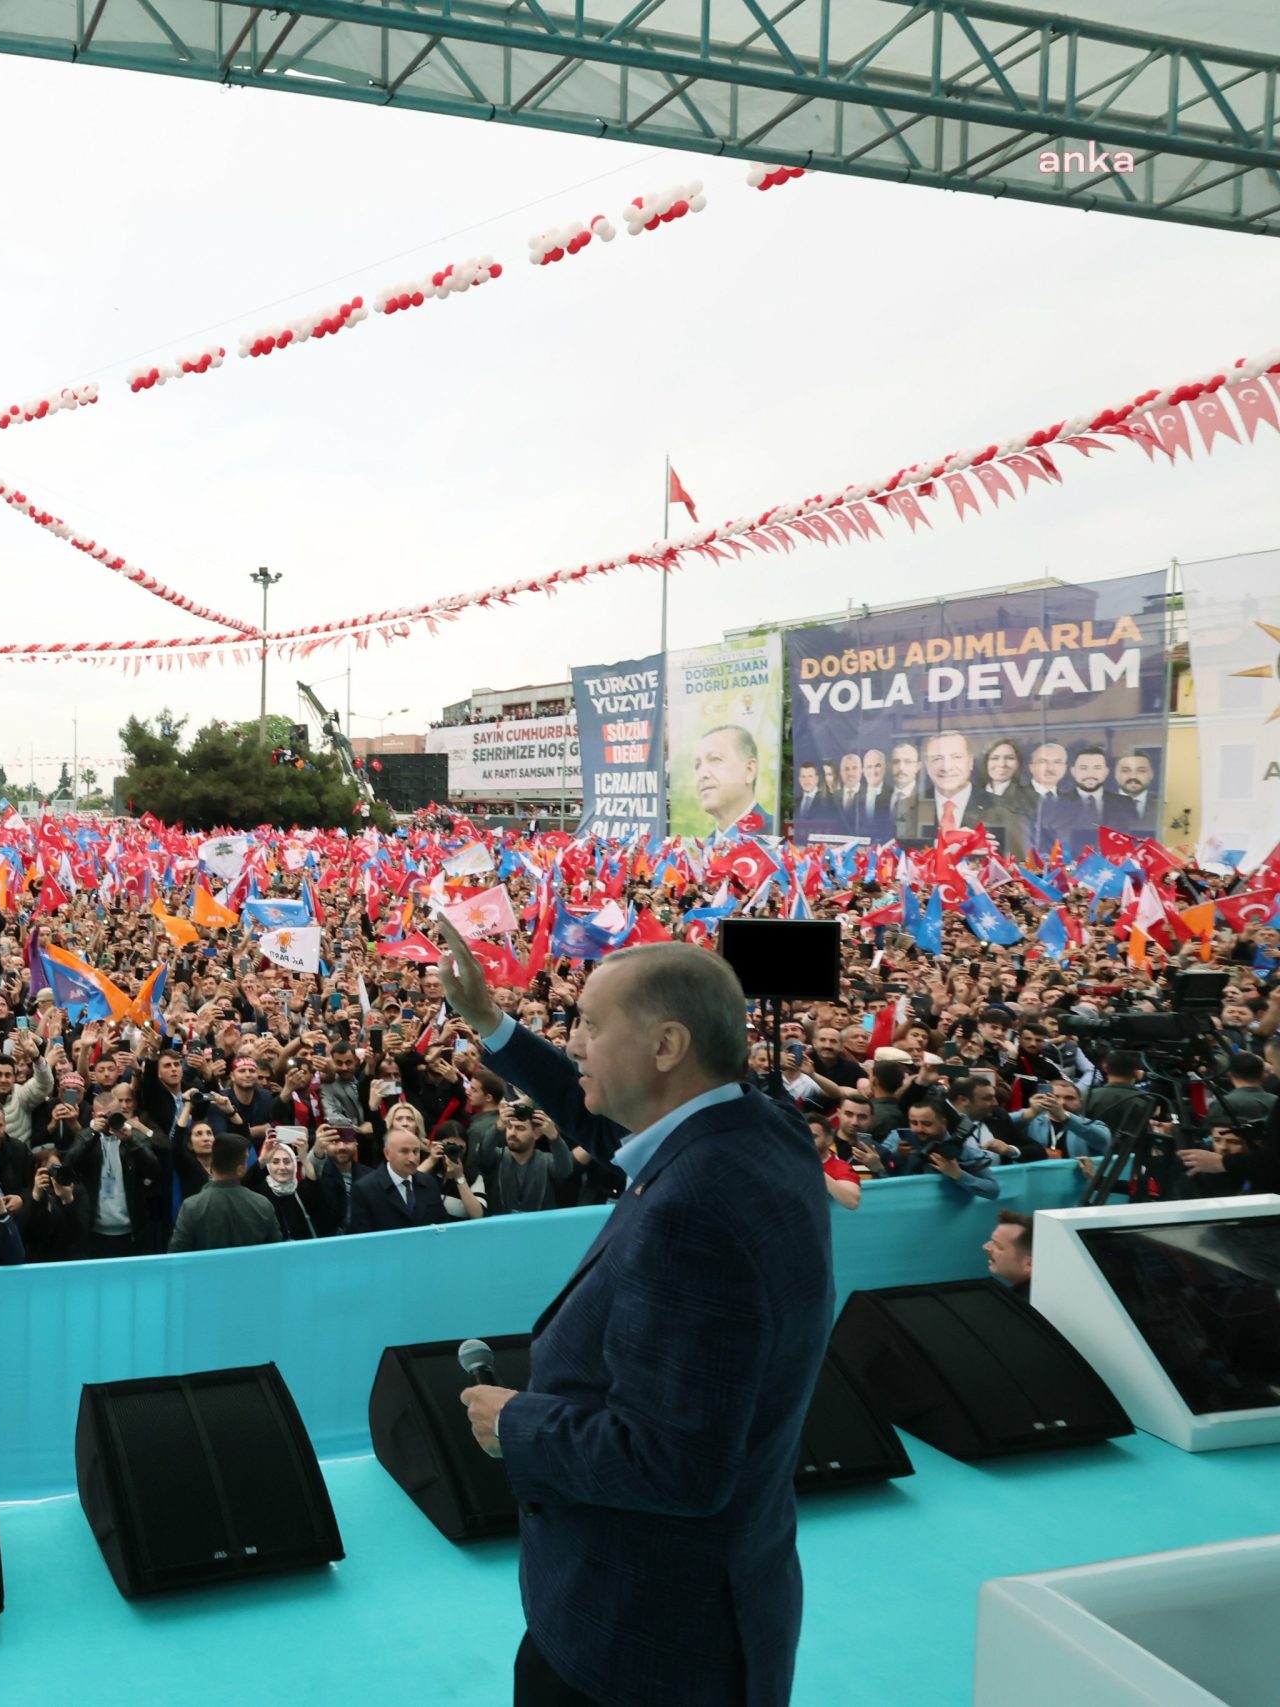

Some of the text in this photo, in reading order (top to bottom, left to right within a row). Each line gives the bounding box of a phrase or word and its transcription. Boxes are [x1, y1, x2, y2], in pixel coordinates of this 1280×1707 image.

[800, 616, 1142, 680] DOĞRU ADIMLARLA
[685, 659, 768, 681] DOĞRU ZAMAN
[685, 673, 769, 694] DOĞRU ADAM
[798, 649, 1140, 714] YOLA DEVAM
[473, 730, 504, 745] SAYIN
[472, 744, 535, 764] ŞEHRİMİZE
[538, 742, 565, 760] HOŞ
[482, 769, 493, 779] AK
[495, 767, 518, 779] PARTİ
[519, 767, 554, 778] SAMSUN
